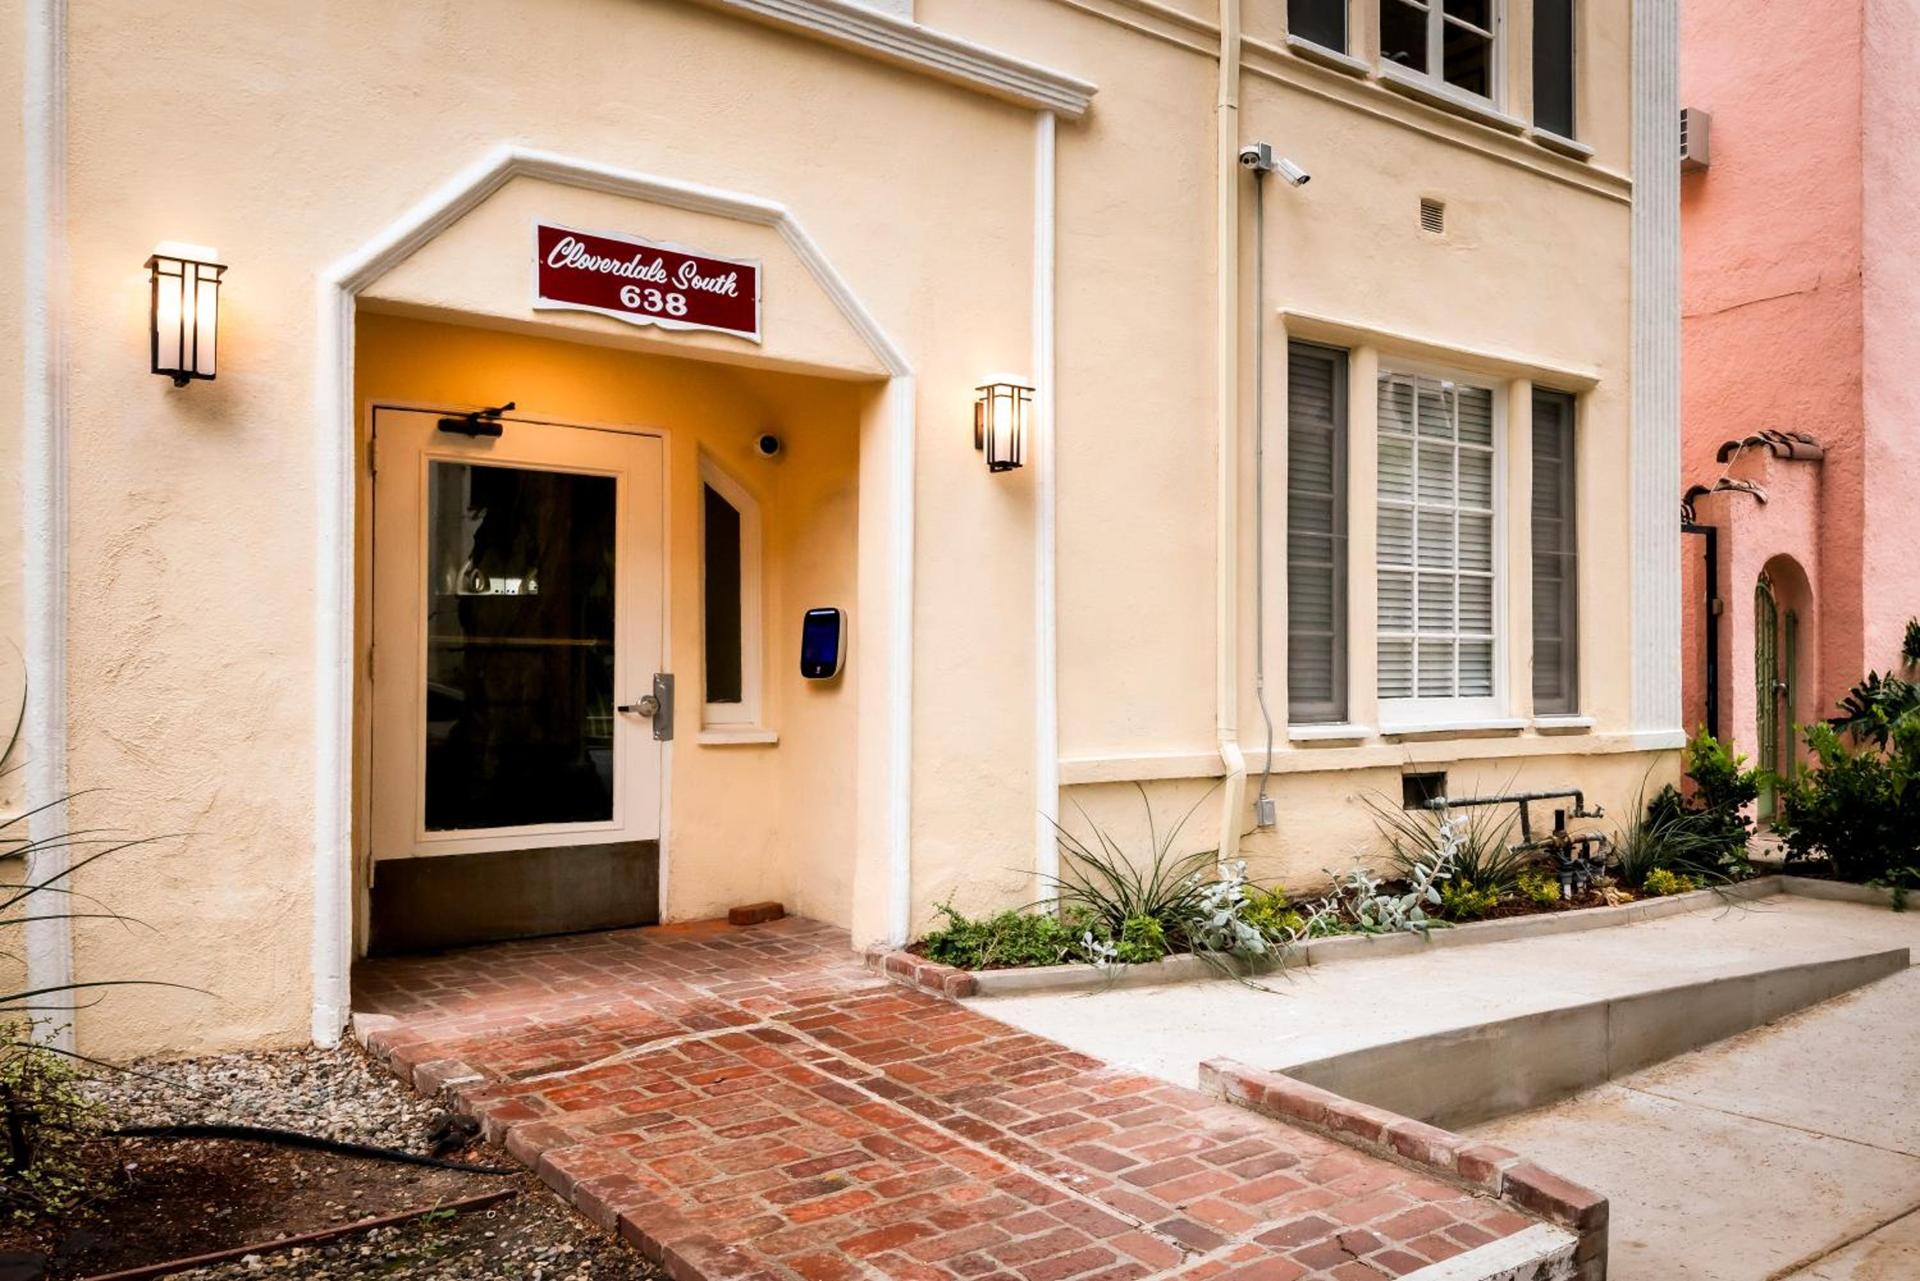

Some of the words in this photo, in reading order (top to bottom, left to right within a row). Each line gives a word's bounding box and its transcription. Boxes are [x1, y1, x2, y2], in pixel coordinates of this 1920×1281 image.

[547, 236, 668, 284] Cloverdale
[671, 260, 738, 298] South
[620, 285, 688, 317] 638
